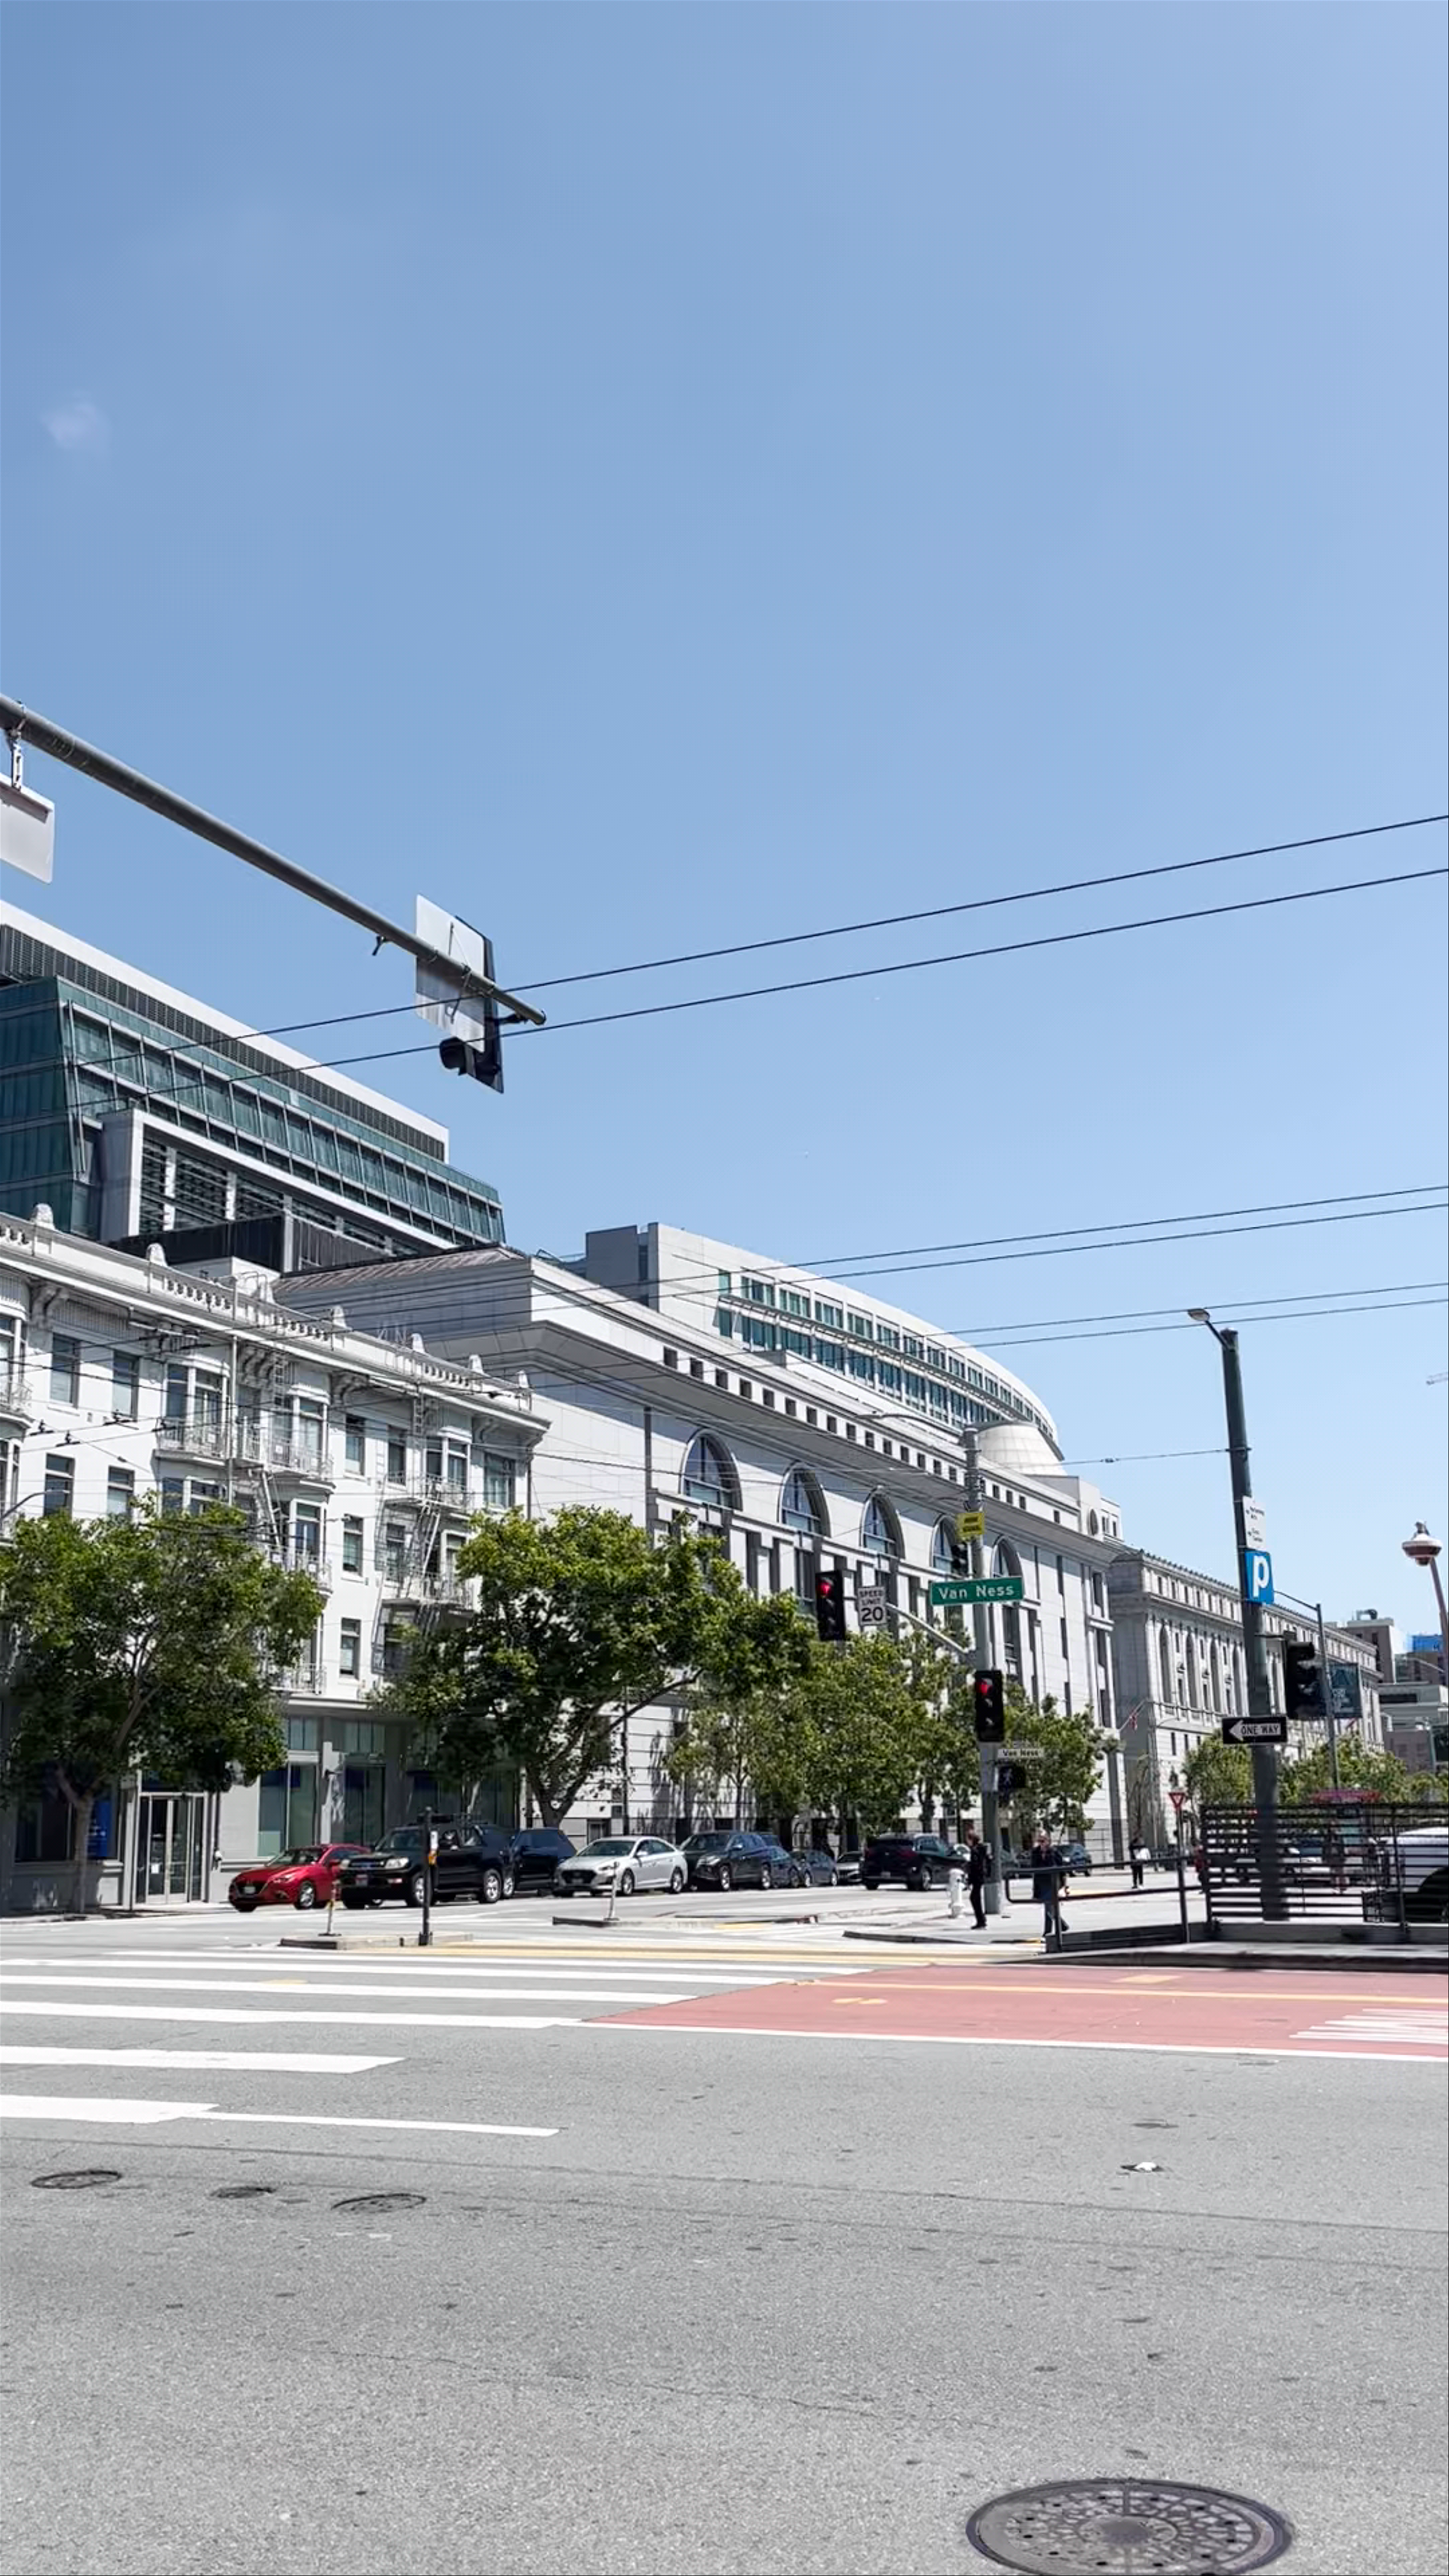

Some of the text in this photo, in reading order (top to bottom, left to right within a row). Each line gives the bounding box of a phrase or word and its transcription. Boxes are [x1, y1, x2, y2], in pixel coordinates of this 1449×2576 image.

[938, 1585, 1014, 1599] Van Ness
[861, 1607, 883, 1622] 20
[1241, 1725, 1278, 1735] ONE WAY
